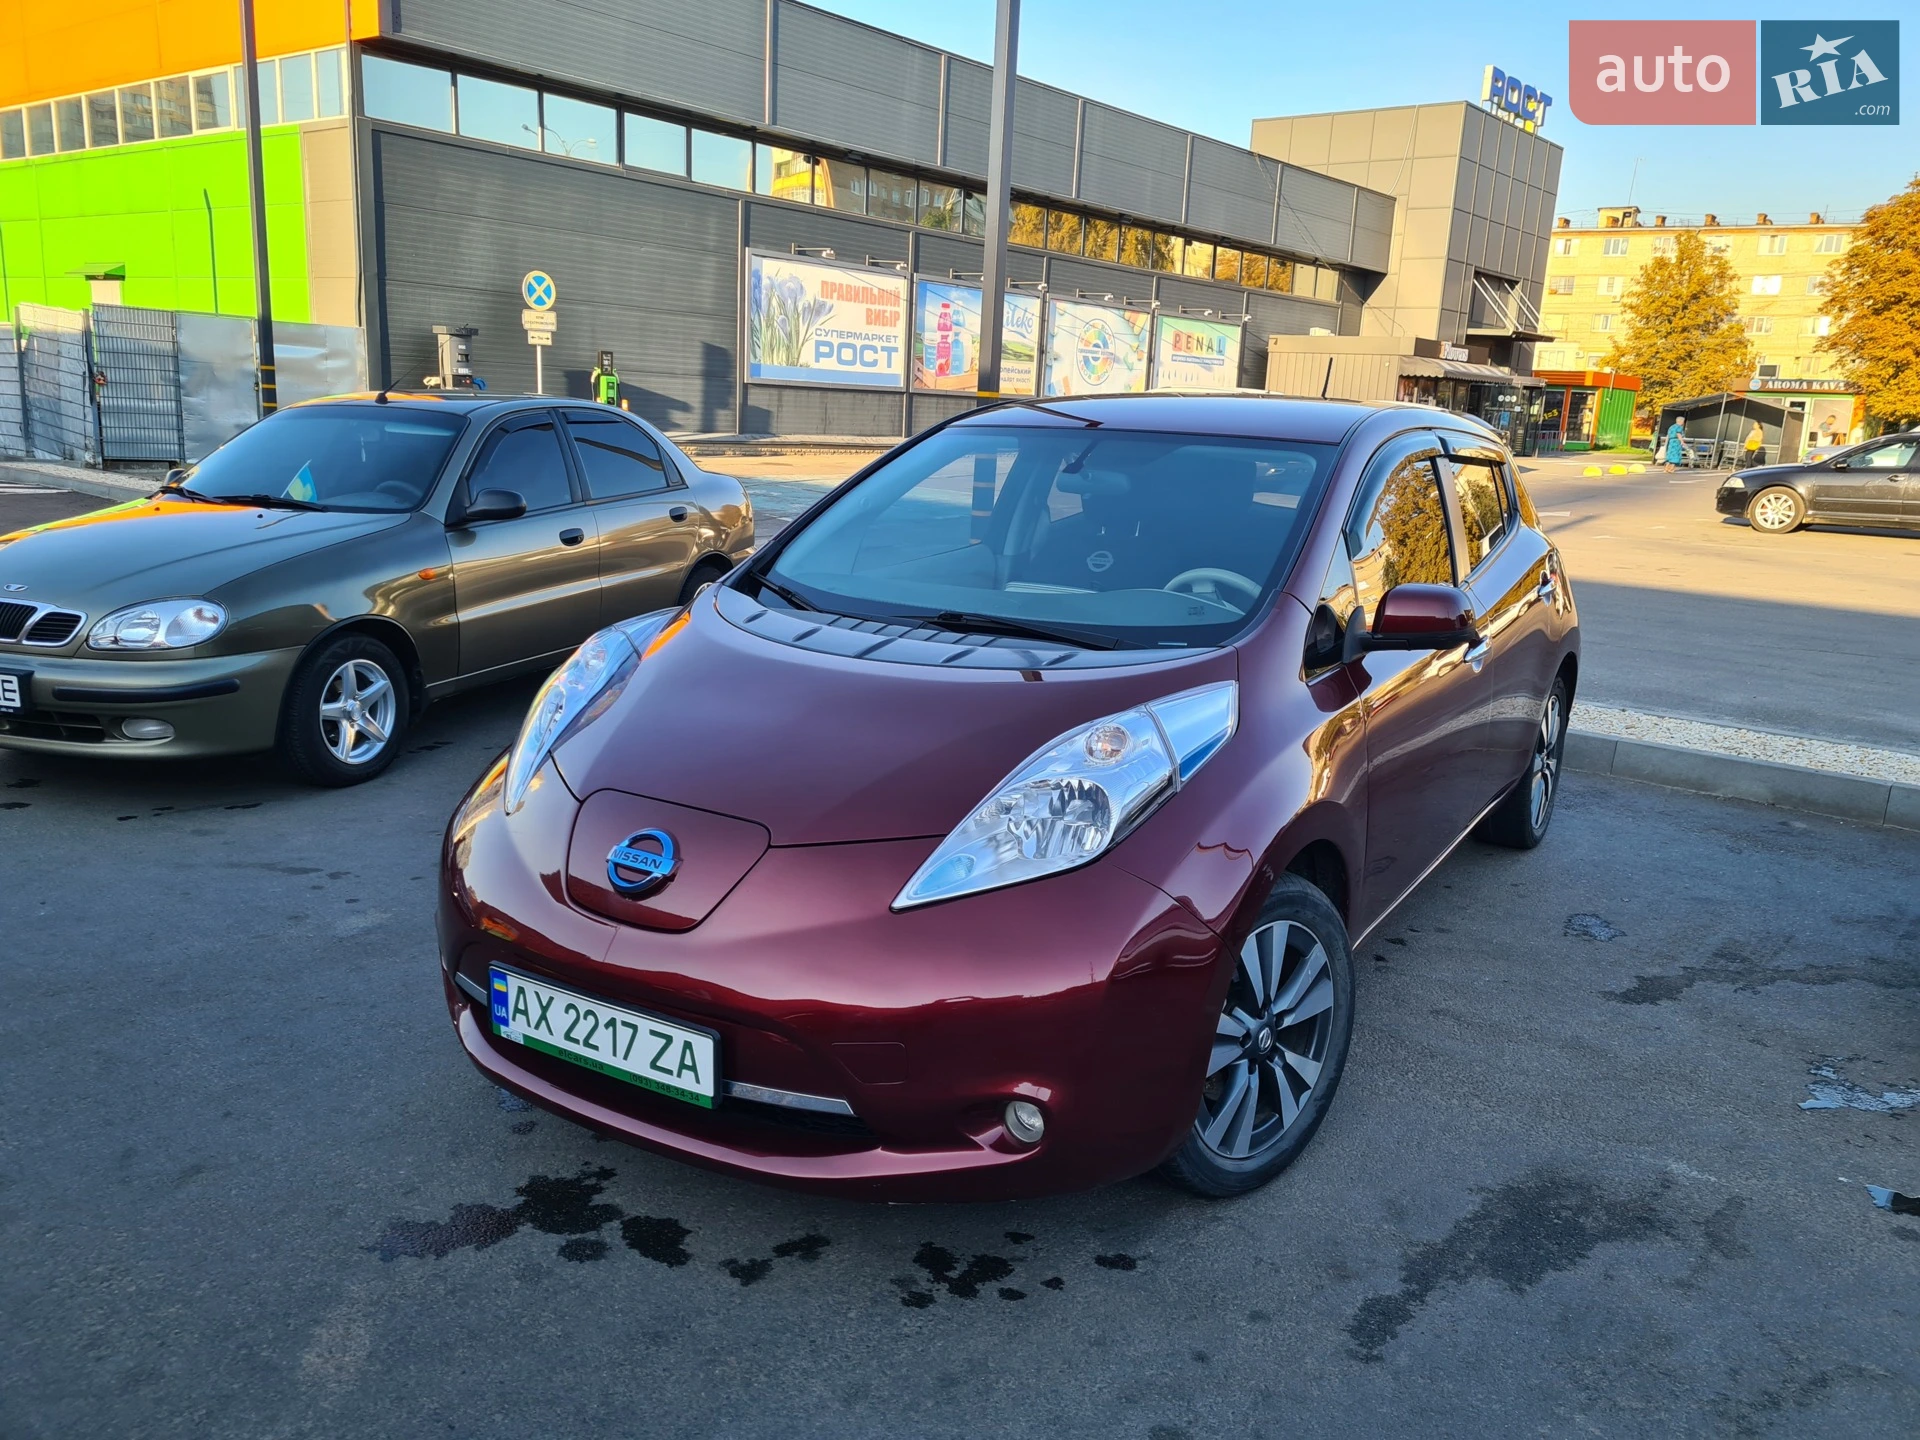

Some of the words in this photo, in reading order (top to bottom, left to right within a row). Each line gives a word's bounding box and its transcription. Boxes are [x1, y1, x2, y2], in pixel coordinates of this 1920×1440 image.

[820, 279, 901, 308] ПРАВИЛЬНИЙ
[865, 307, 901, 328] ВИБІР
[814, 327, 899, 344] СУПЕРМАРКЕТ
[1174, 333, 1224, 353] PENAL
[814, 339, 899, 369] РОСТ
[1000, 366, 1032, 375] опейський
[1765, 380, 1808, 390] AROMA
[1811, 381, 1846, 391] KAVA
[611, 848, 662, 870] NISSAN
[494, 1004, 508, 1019] UA
[511, 985, 554, 1036] AX
[563, 1002, 639, 1062] 2217
[649, 1028, 701, 1085] ZA
